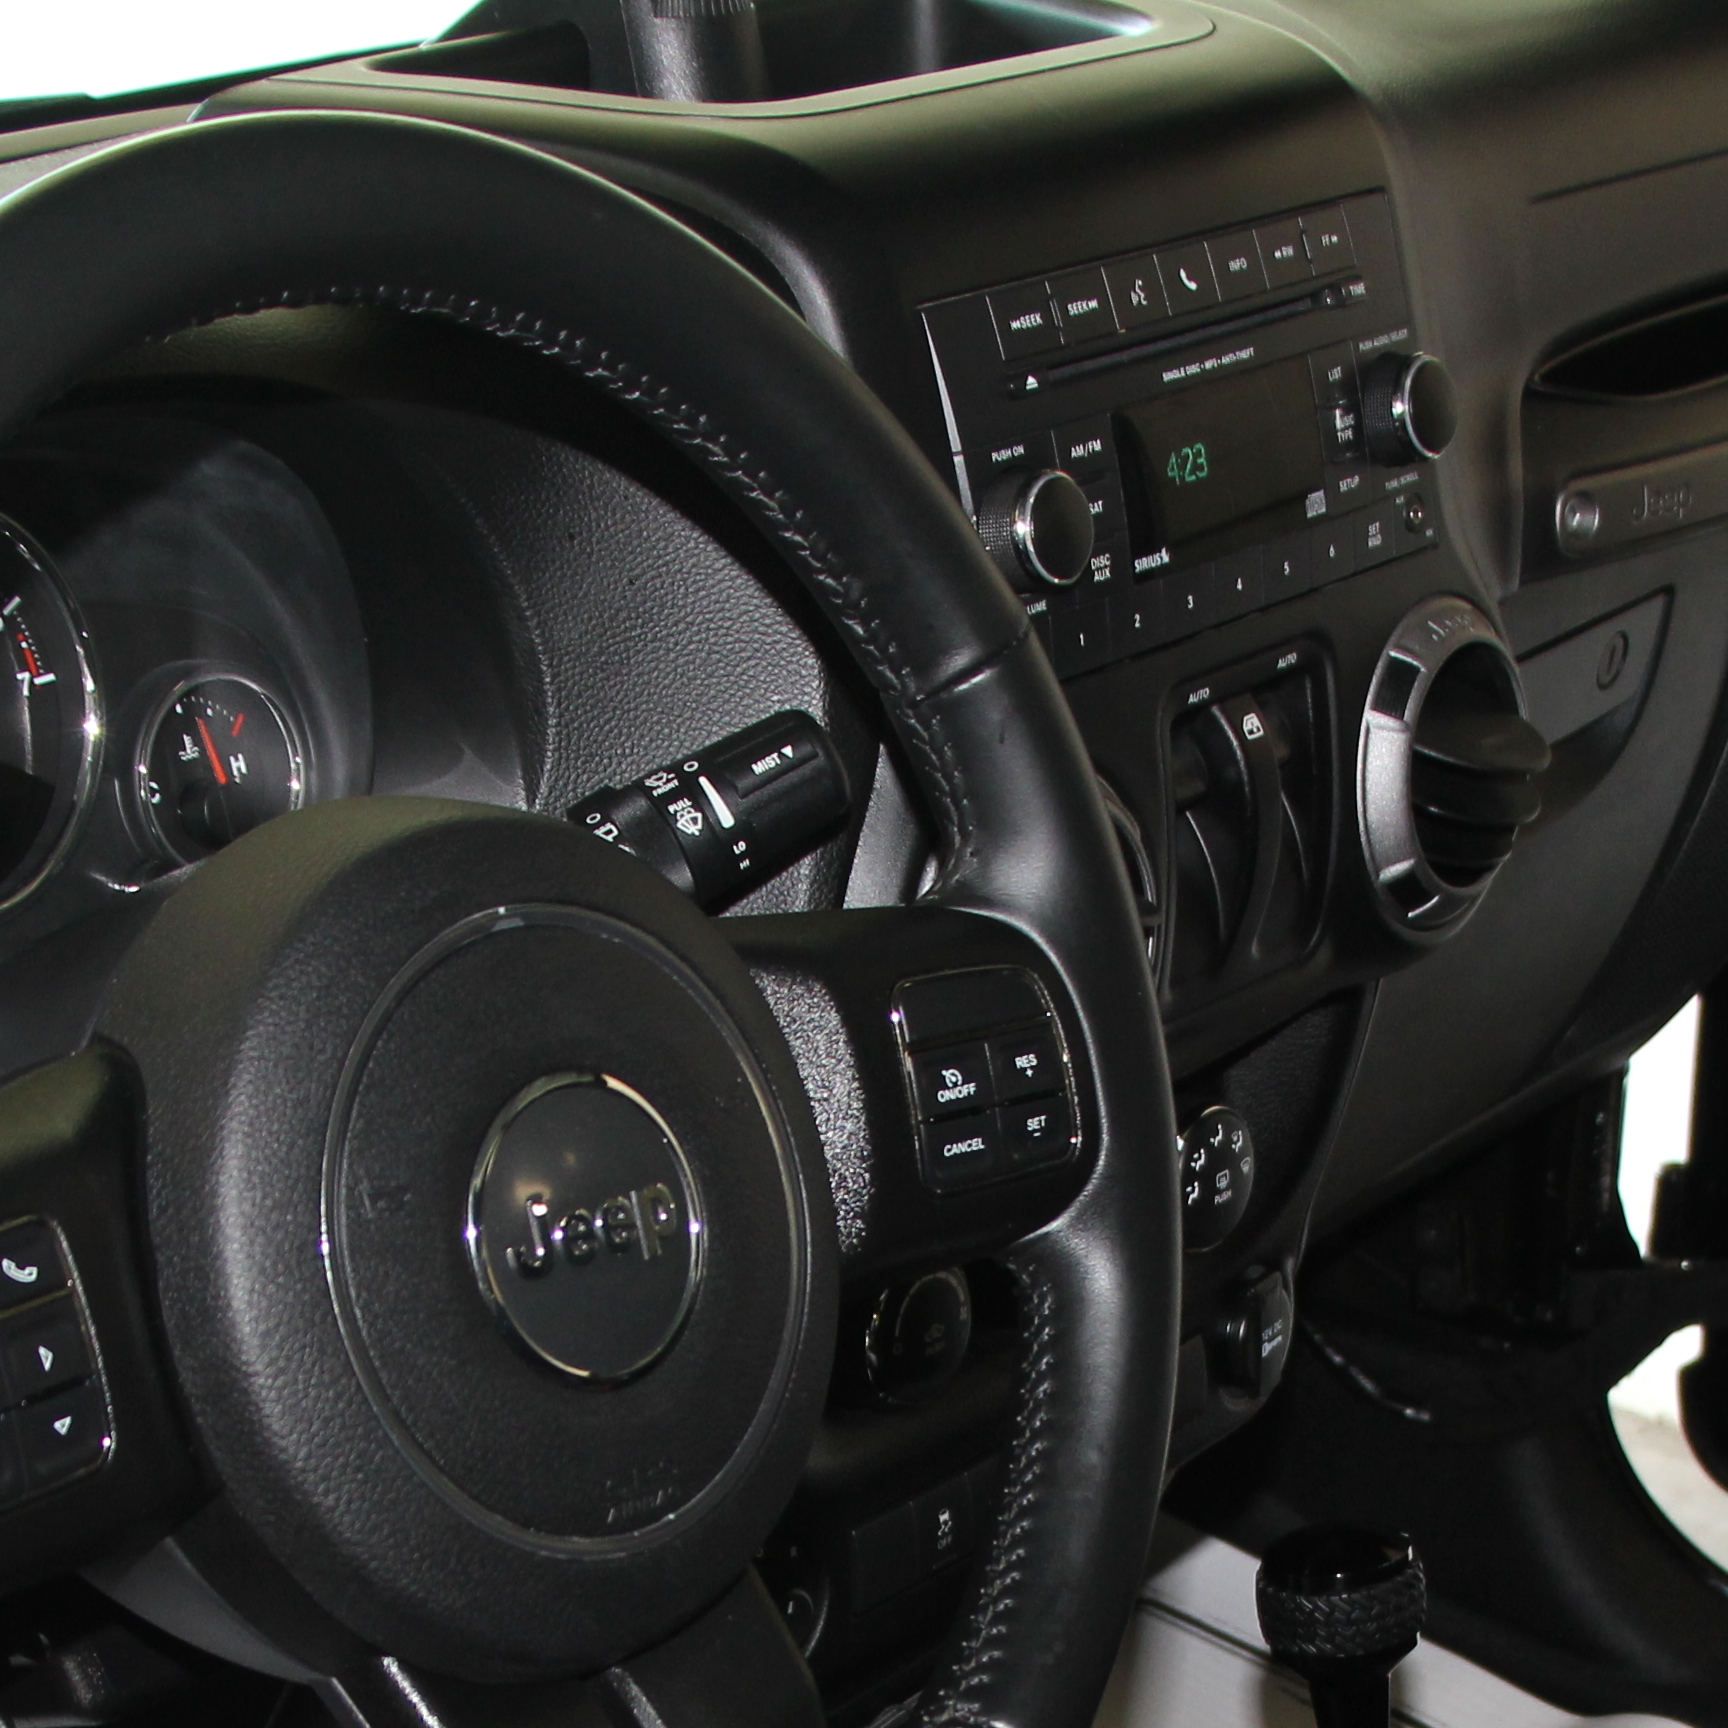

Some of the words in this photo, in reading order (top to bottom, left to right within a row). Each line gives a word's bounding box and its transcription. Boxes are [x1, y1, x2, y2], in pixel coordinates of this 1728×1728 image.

[1228, 257, 1248, 273] INFO
[1067, 299, 1089, 317] SEEK
[1020, 312, 1043, 329] SEEK
[1328, 366, 1342, 382] LIST
[991, 450, 1012, 464] PUSH
[1013, 444, 1026, 459] ON
[1070, 439, 1102, 459] AM/FM
[1167, 443, 1209, 486] 4:23
[1089, 500, 1104, 515] SAT
[1090, 553, 1111, 571] DISC
[1134, 551, 1162, 573] SIRIUS
[1283, 560, 1290, 575] 5
[1093, 567, 1111, 583] AUX
[1236, 577, 1243, 591] 4
[1026, 599, 1048, 616] LUME
[1186, 594, 1194, 609] 3
[1133, 613, 1141, 628] 2
[1277, 652, 1298, 669] AUTO
[15, 670, 32, 697] 7
[1187, 687, 1210, 704] AUTO
[229, 753, 248, 778] H
[750, 751, 783, 776] MIST
[652, 777, 680, 798] FRONT
[666, 797, 694, 815] PULL
[732, 840, 747, 855] LO
[1015, 1053, 1038, 1069] RES
[937, 1083, 977, 1103] ON/OFF
[1026, 1115, 1047, 1131] SET
[943, 1136, 985, 1157] CANCEL
[505, 1182, 677, 1280] Jeep
